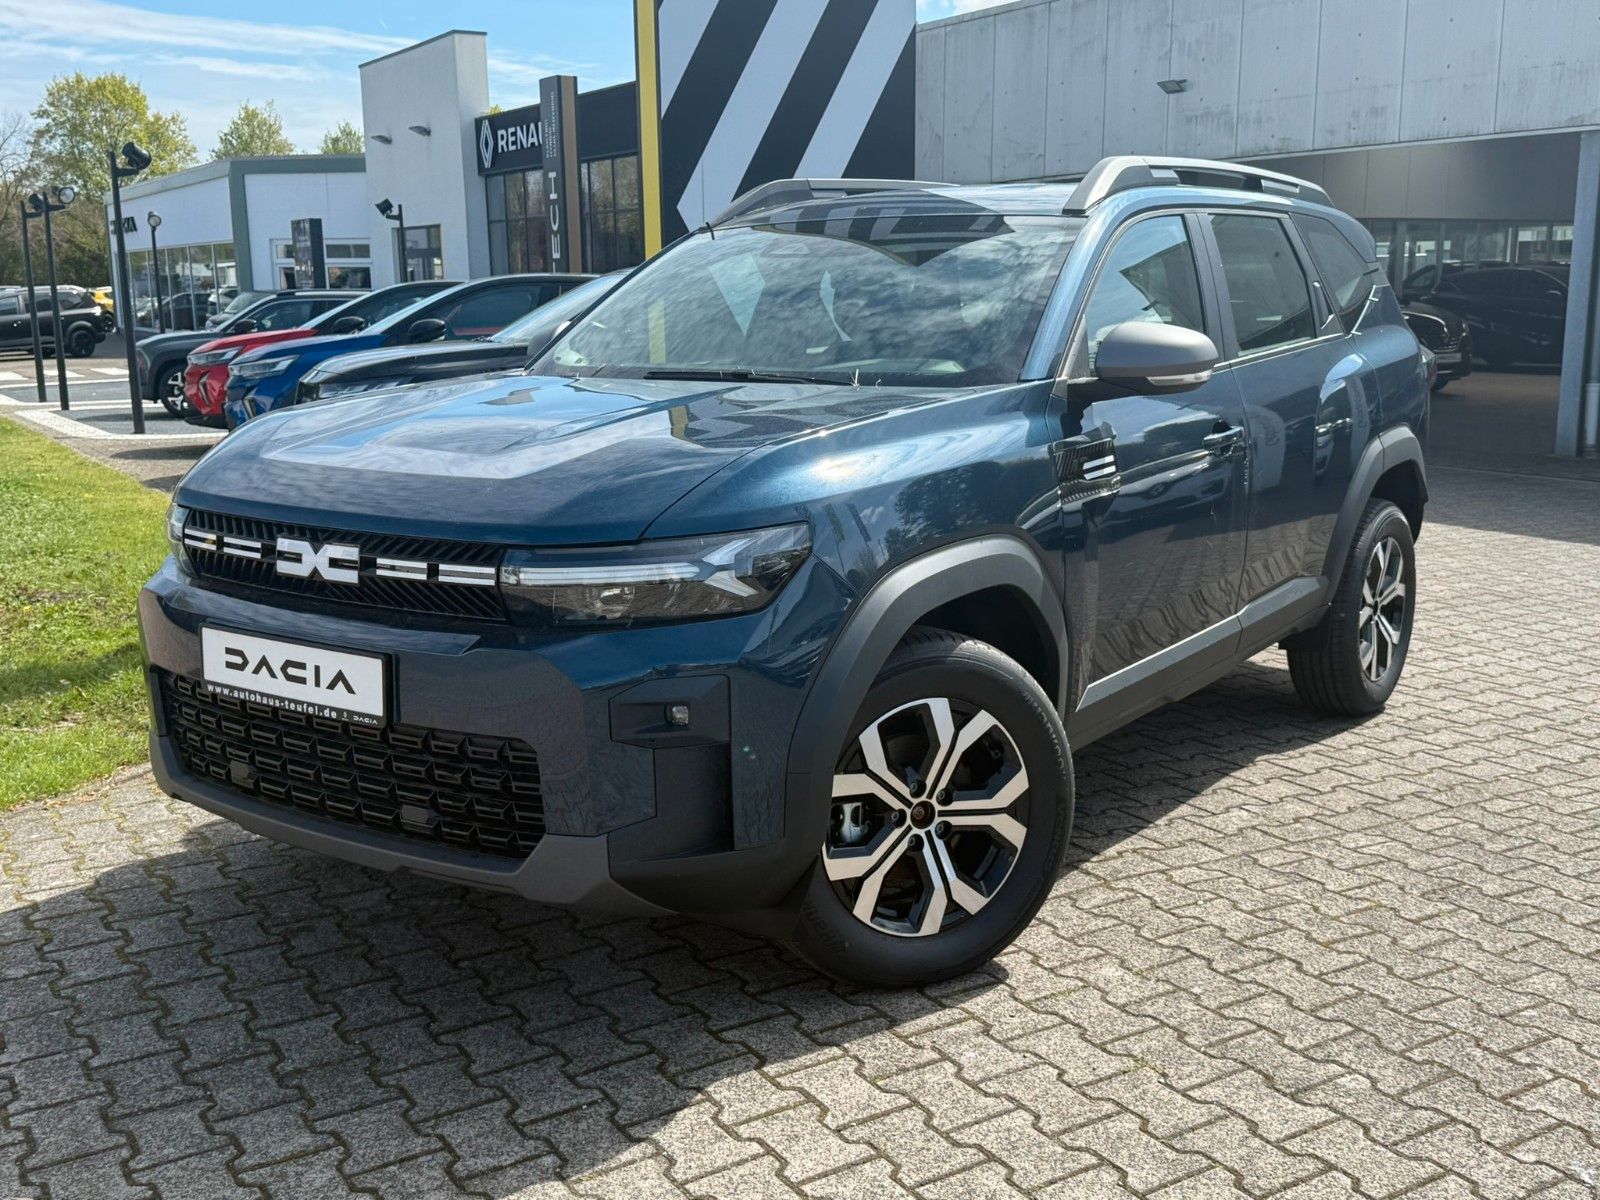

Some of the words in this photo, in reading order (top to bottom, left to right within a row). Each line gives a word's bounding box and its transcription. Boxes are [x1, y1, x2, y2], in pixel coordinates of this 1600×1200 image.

[225, 647, 356, 695] DACIA
[207, 684, 337, 719] www.autohaus-teufel.de
[353, 715, 378, 725] DACIA
